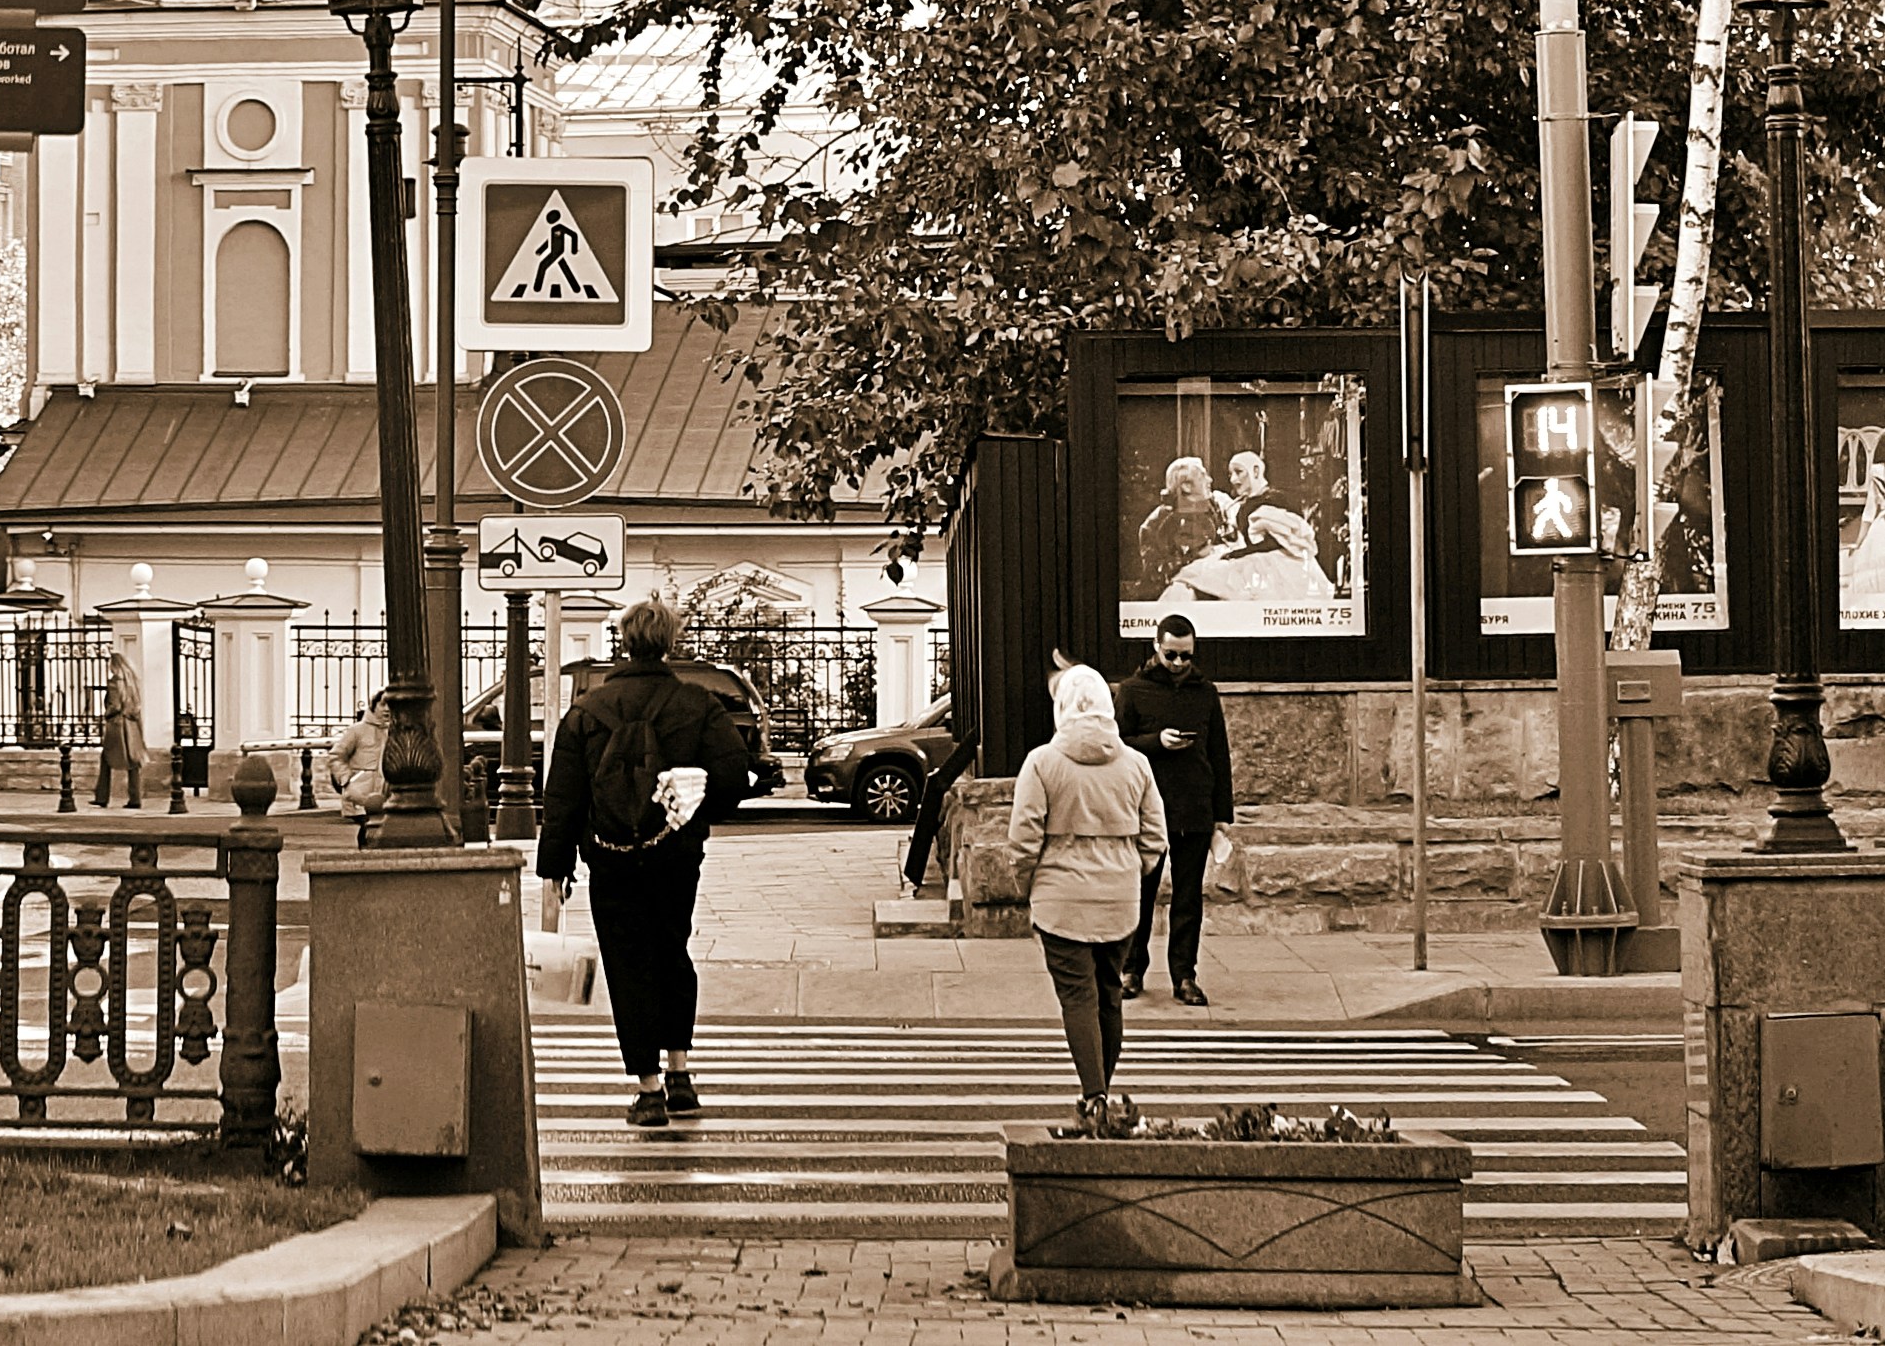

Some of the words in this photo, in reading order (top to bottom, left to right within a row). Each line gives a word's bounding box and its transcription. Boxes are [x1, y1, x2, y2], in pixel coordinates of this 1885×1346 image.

[1536, 406, 1577, 452] 14
[1691, 602, 1716, 613] 75
[1327, 608, 1352, 619] 75
[1119, 617, 1158, 628] ДЕЛКА
[1263, 617, 1322, 626] ПУШКИНА
[1482, 615, 1509, 624] БУРЯ
